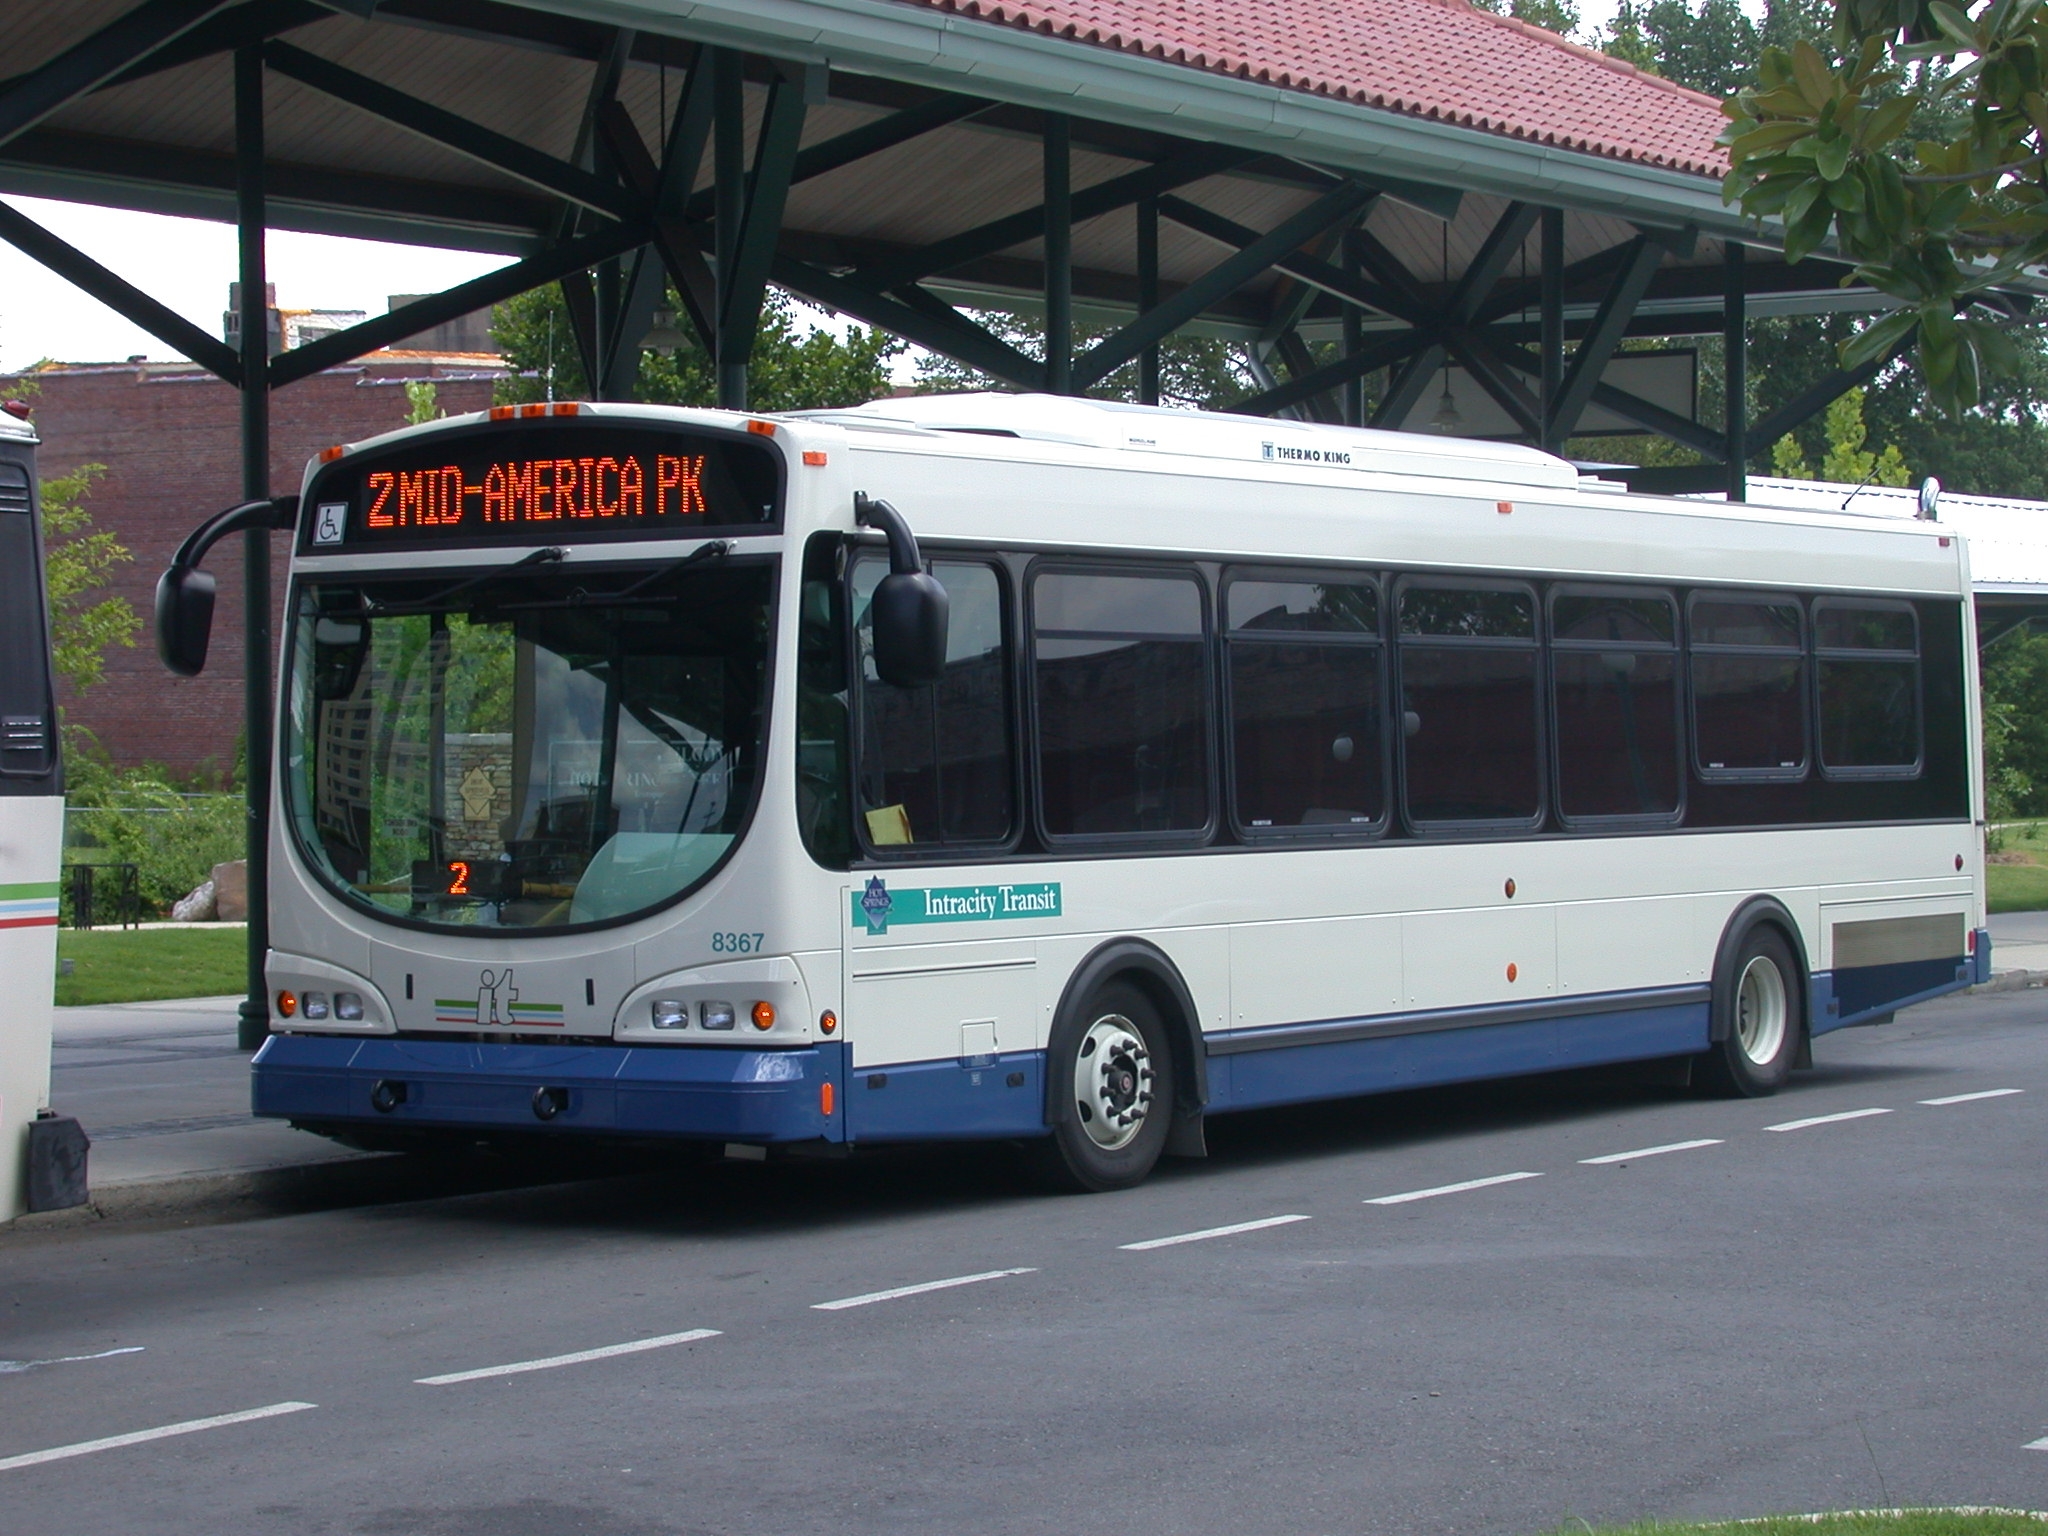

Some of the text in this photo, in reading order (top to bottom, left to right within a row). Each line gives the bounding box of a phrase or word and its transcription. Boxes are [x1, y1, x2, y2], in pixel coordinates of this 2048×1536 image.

[1277, 447, 1351, 464] THERMO KING
[656, 453, 706, 514] PK
[449, 861, 470, 895] 2
[863, 897, 890, 907] SPRINGS
[868, 888, 883, 897] HOT
[924, 885, 1056, 919] Intracity Transit
[712, 932, 765, 953] 8367
[476, 968, 519, 1025] it
